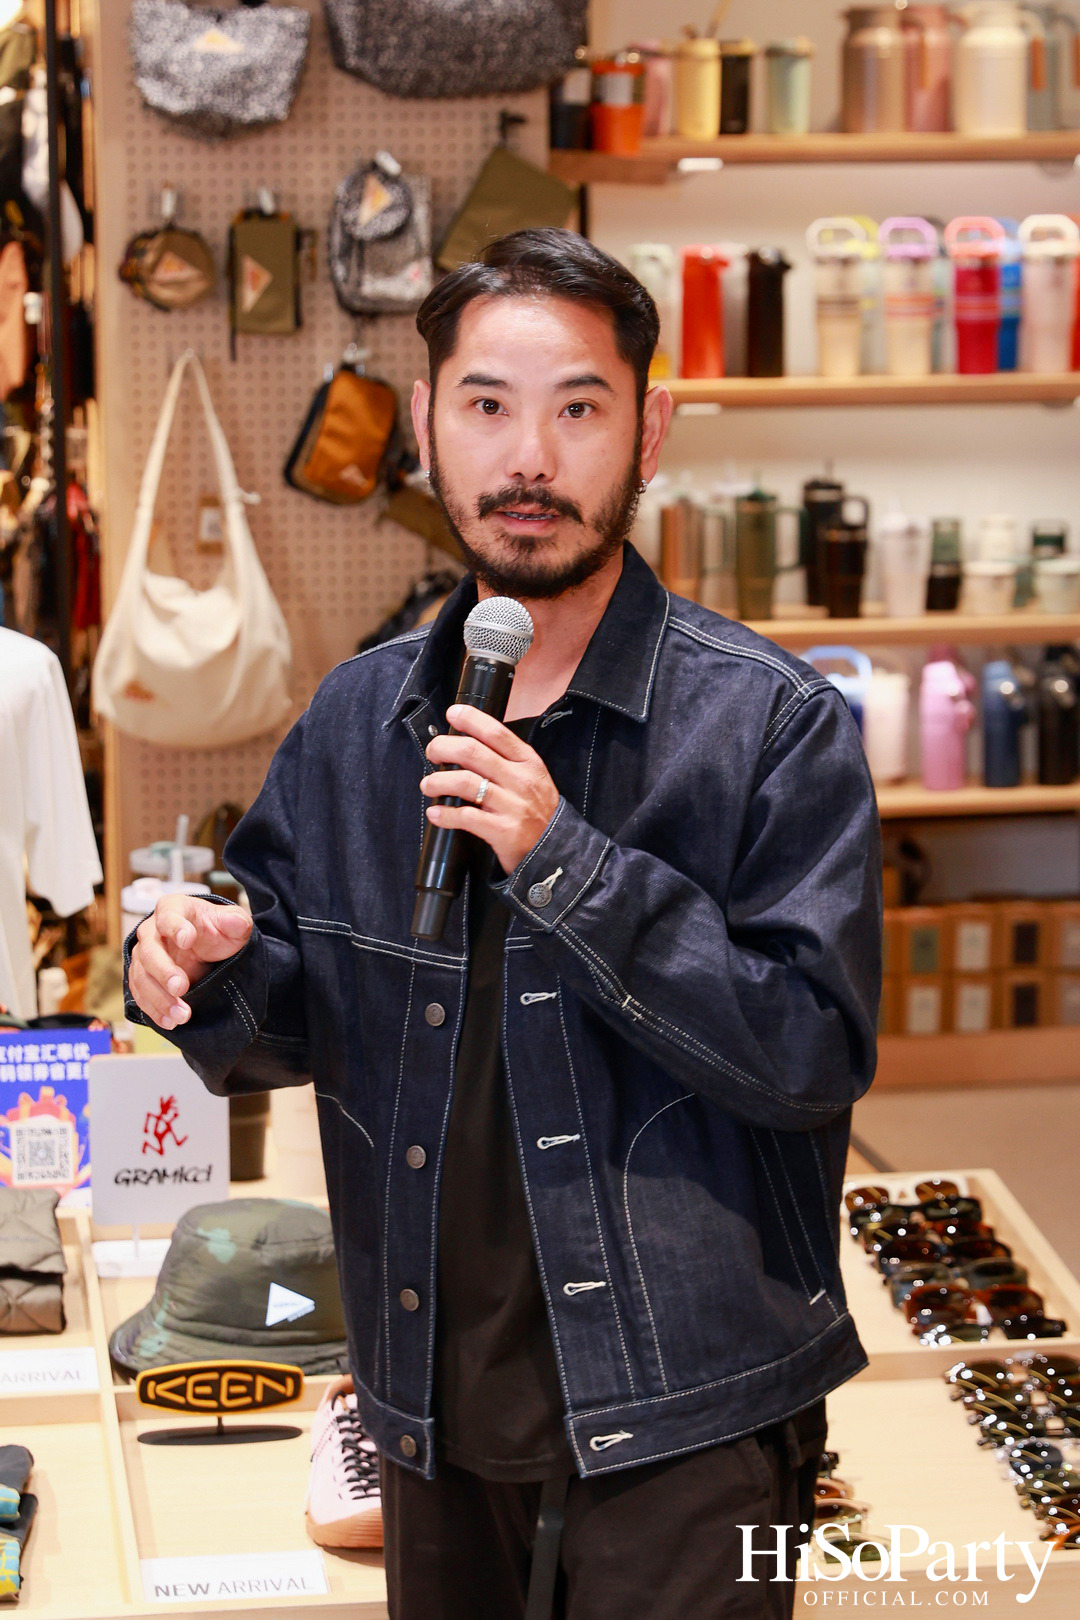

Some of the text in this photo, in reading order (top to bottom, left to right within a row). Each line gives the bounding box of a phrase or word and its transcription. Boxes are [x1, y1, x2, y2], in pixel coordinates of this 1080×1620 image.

[1, 1369, 87, 1384] ARRIVAL
[147, 1371, 294, 1408] KEEN
[154, 1577, 314, 1597] NEW ARRIVAL
